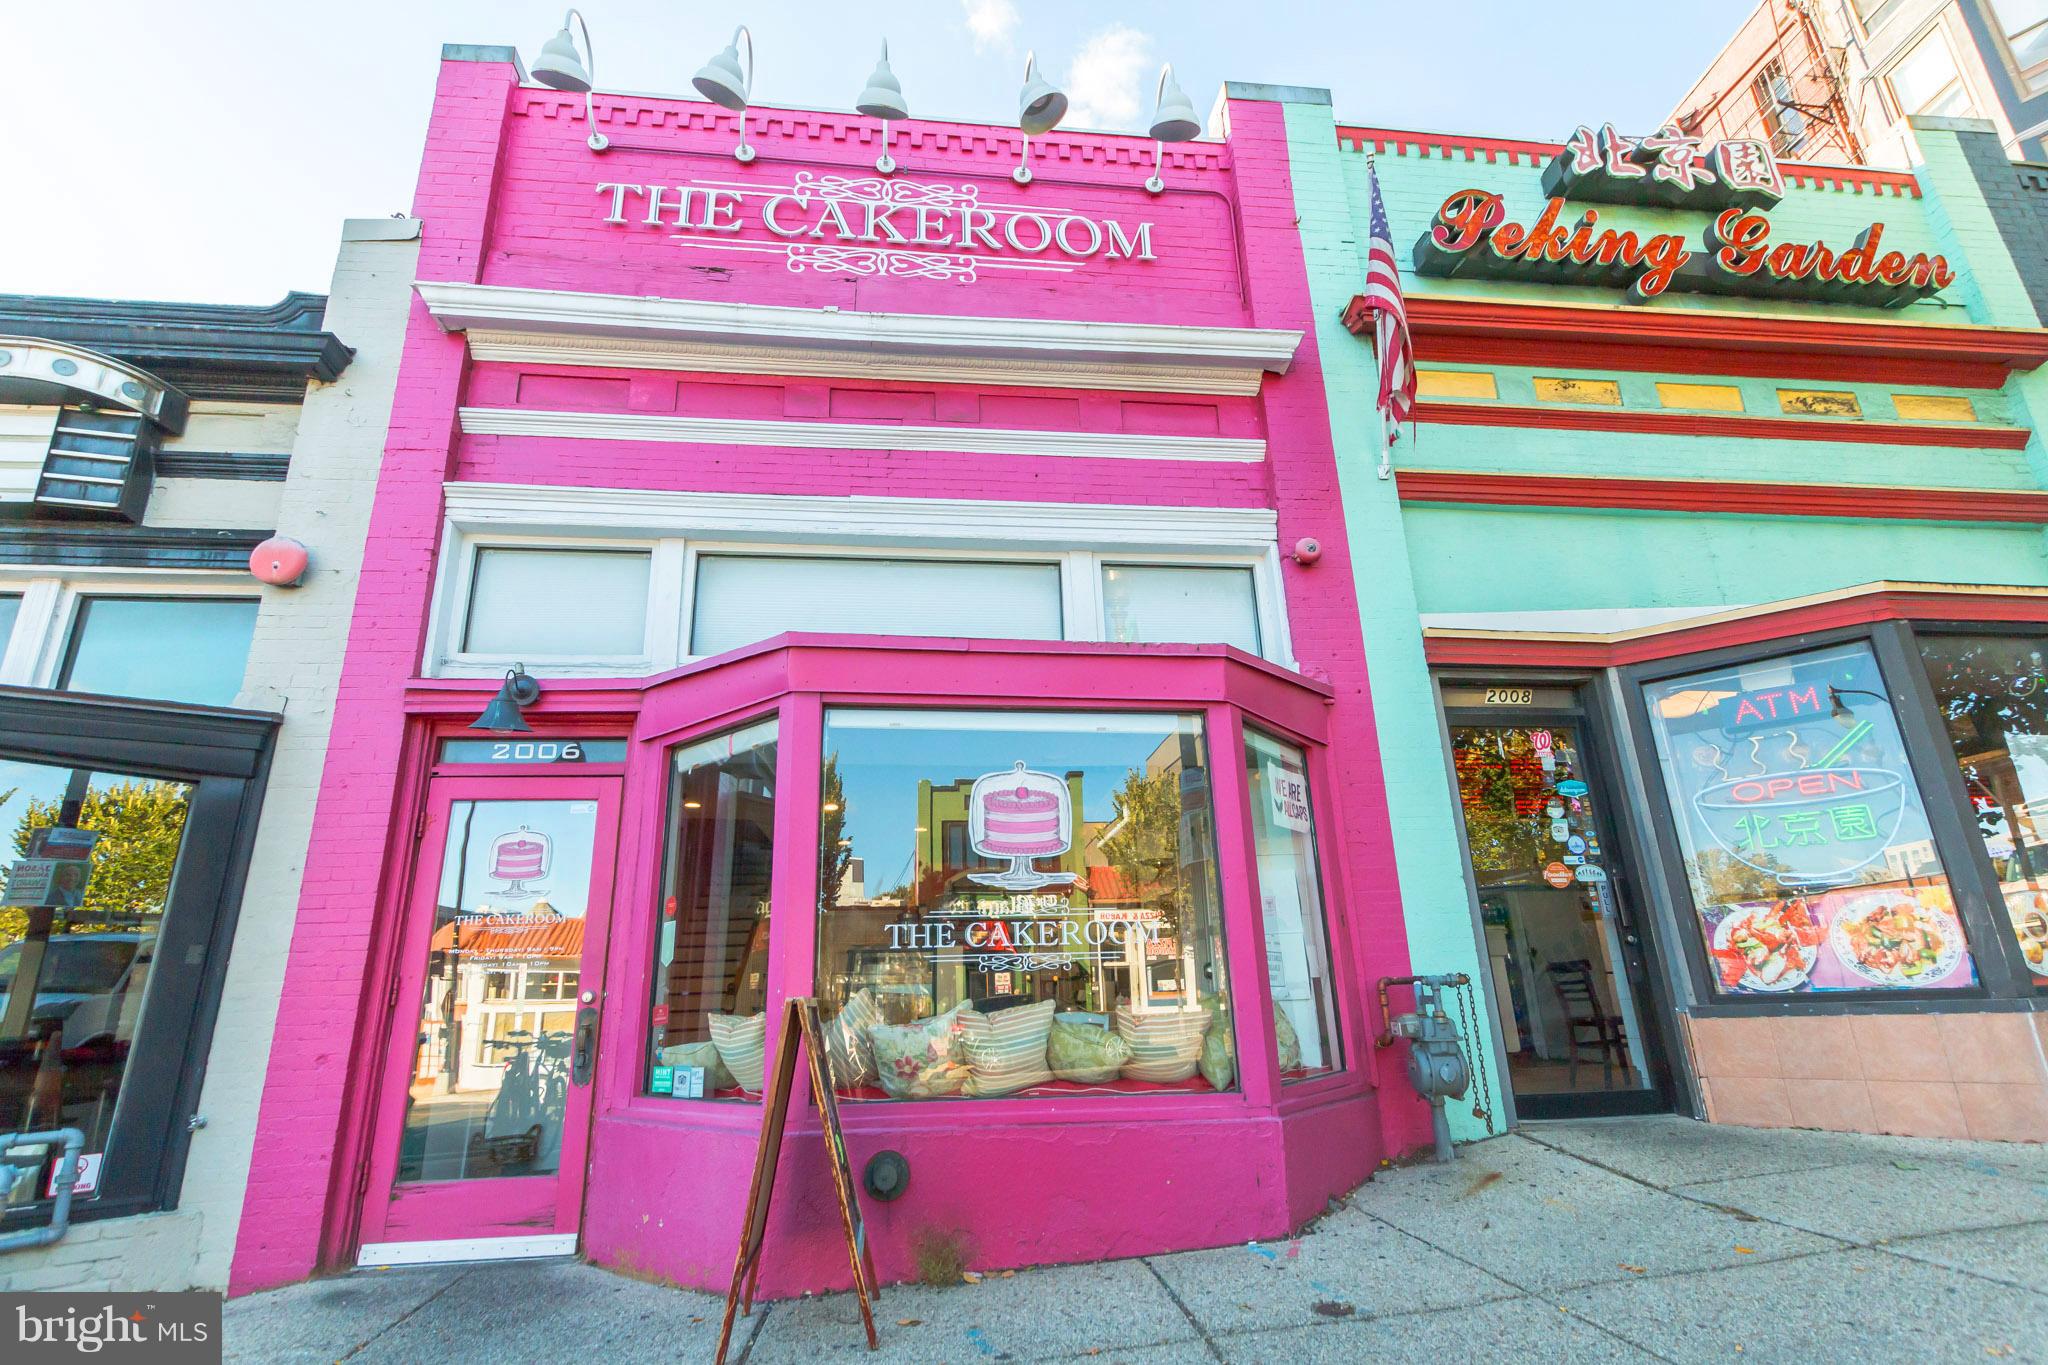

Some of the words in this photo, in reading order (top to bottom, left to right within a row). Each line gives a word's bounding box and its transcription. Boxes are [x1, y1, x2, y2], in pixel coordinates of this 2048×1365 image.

[1570, 121, 1786, 199] 北京園
[595, 182, 744, 232] THE
[760, 193, 1158, 260] CAKEROOM
[1431, 188, 1691, 297] Peking
[1716, 208, 1956, 289] Garden
[1487, 689, 1531, 703] 2008
[1735, 686, 1820, 724] ATM
[491, 743, 581, 759] 2006
[1288, 781, 1302, 803] ARE
[1731, 769, 1863, 803] OPEN
[1734, 804, 1878, 850] 北京園
[1601, 884, 1610, 913] PULL
[454, 915, 483, 926] THE
[486, 913, 568, 926] CAKEROOM
[884, 922, 956, 950] THE
[964, 919, 1160, 949] CAKEROOM
